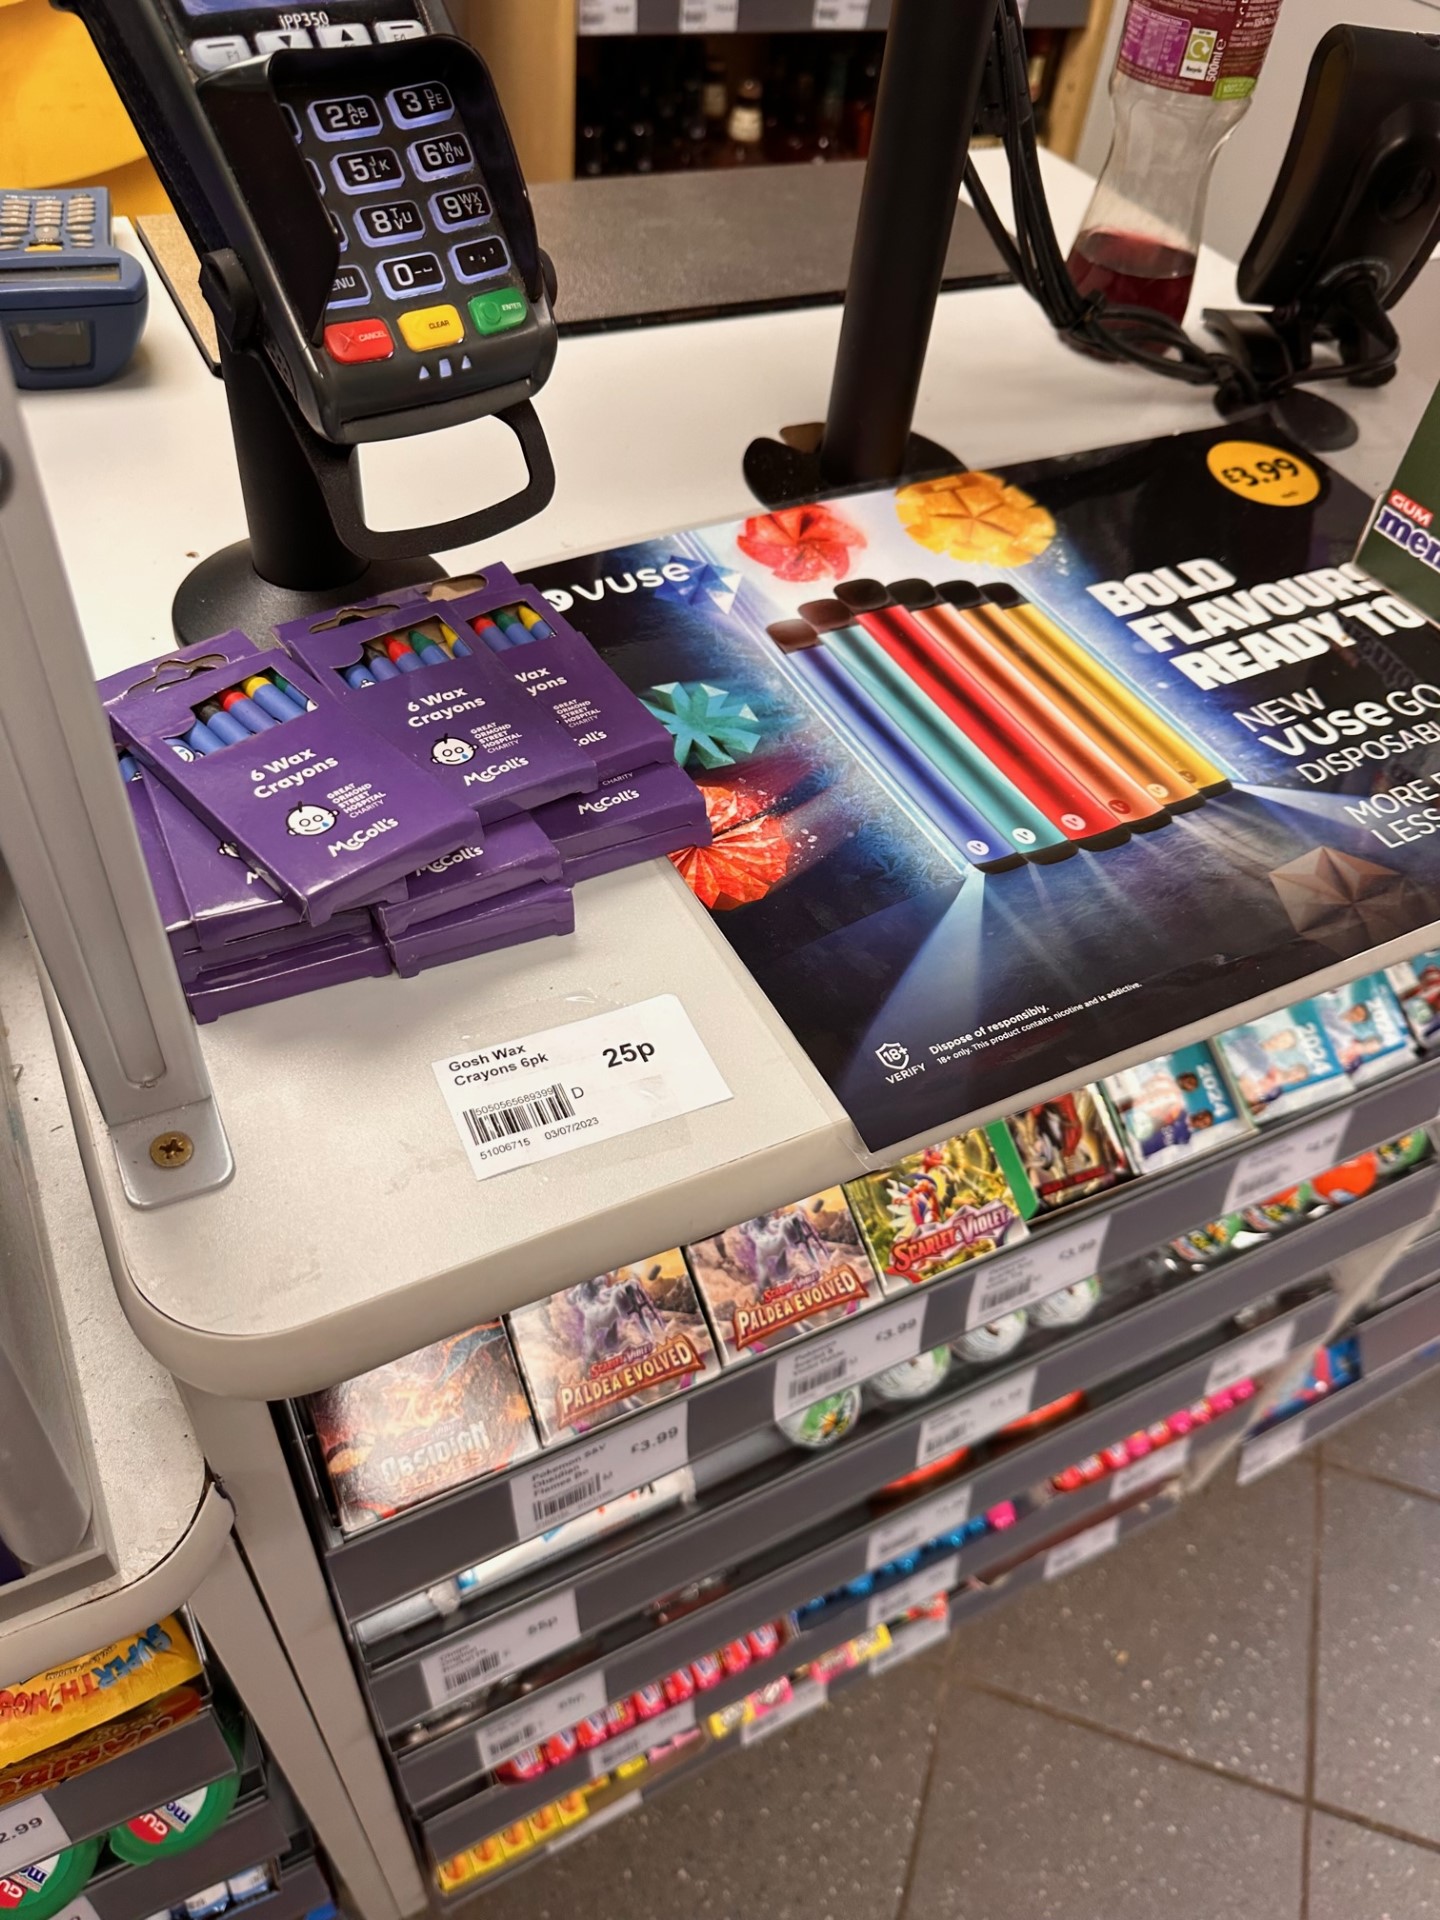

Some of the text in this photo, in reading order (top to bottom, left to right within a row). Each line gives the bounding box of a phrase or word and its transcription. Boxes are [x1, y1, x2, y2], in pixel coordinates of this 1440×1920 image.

[402, 91, 422, 113] 3
[326, 105, 348, 128] 2
[422, 144, 443, 166] 6
[348, 158, 370, 181] 5
[443, 196, 462, 219] 9
[371, 210, 392, 233] 8
[393, 263, 414, 286] 0
[429, 319, 450, 330] CLEAR
[358, 331, 388, 343] CANCEL
[1220, 457, 1299, 488] £3.99
[1391, 493, 1433, 527] GUM
[1086, 557, 1238, 617] BOLD
[1169, 595, 1427, 691] READY TO
[407, 687, 468, 712] 6 Wax
[553, 699, 577, 711] GREAT
[556, 700, 592, 715] ORMOND
[1232, 686, 1328, 733] NEW
[1386, 683, 1440, 716] GO
[408, 698, 486, 727] Crayons
[561, 706, 588, 719] STREET
[564, 708, 601, 724] HOSPITAL
[568, 715, 599, 728] CHARITY
[470, 722, 497, 735] GREAT
[474, 723, 512, 740] ORMOND
[478, 730, 508, 744] STREET
[483, 732, 523, 749] HOSPITAL
[487, 739, 521, 754] CHARITY
[250, 748, 317, 782] 6 Wax
[463, 756, 530, 787] McColl's
[253, 757, 339, 798] Crayons
[602, 772, 634, 786] CHARITY
[326, 783, 356, 800] GREAT
[332, 783, 372, 804] ORMOND
[338, 790, 370, 809] STREET
[343, 791, 387, 814] HOSPITAL
[578, 789, 640, 815] McColl's
[1343, 779, 1440, 825] MORE
[350, 799, 385, 819] CHARITY
[327, 818, 399, 858] McColl's
[928, 1004, 1050, 1055] Dispose of responsibly.
[936, 1054, 952, 1065] 18+
[952, 1047, 973, 1059] only.
[971, 1040, 990, 1051] This
[989, 1028, 1021, 1045] product
[1021, 1015, 1054, 1032] contains
[1053, 1004, 1084, 1020] nicotine
[1083, 997, 1100, 1008] and
[1106, 982, 1143, 999] addictive.
[448, 1045, 527, 1072] Gosh Wax
[602, 1041, 656, 1070] 25p
[882, 1045, 909, 1065] 18+
[454, 1053, 549, 1086] Crayons 6pk
[885, 1062, 927, 1085] VERIFY
[570, 1086, 584, 1099] D
[480, 1116, 599, 1160] 51006715 03/07/2023
[738, 1270, 857, 1337] PALDEA EVOLVED
[561, 1341, 694, 1414] PALDEA EVOLVED
[630, 1427, 679, 1454] £3.99
